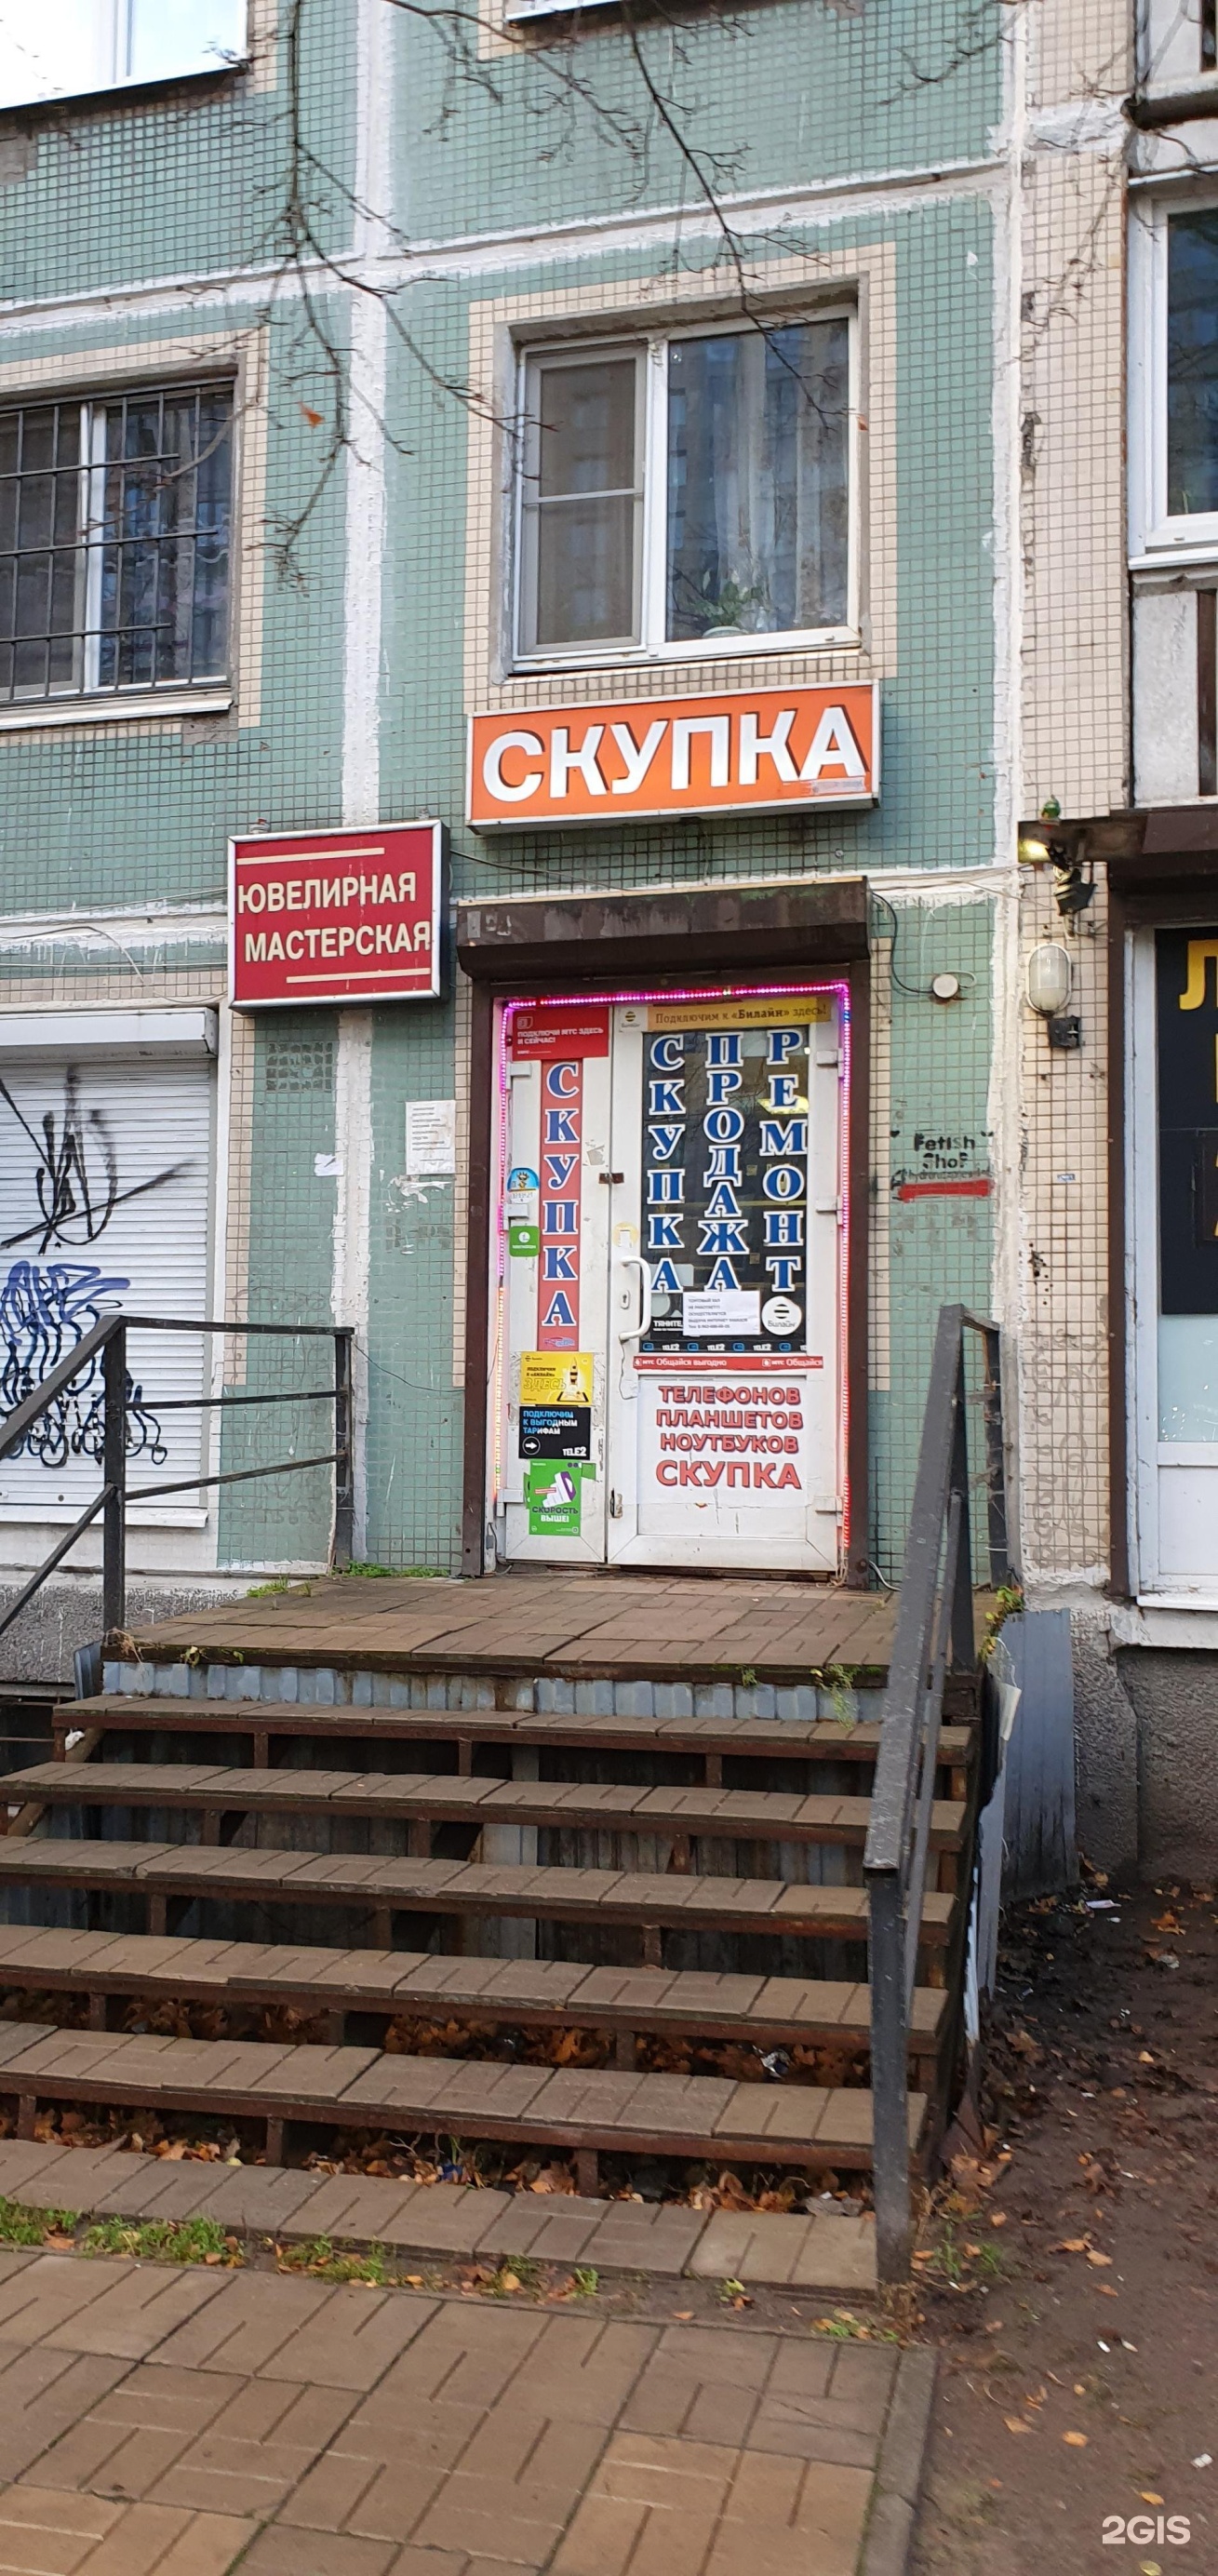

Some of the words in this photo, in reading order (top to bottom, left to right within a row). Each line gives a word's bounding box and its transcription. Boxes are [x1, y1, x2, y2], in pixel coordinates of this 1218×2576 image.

[482, 706, 870, 802] СКУПКА
[237, 872, 416, 914] ЮВЕЛИРНАЯ
[245, 921, 431, 962] МАСТЕРСКАЯ
[655, 1012, 719, 1024] Подключим
[731, 1008, 789, 1020] «Билайн»
[793, 1004, 827, 1016] здесь!
[579, 1026, 604, 1035] ЗДЕСЬ
[647, 1034, 687, 1294] СКУПКА
[696, 1031, 750, 1292] ПРОДАЖА
[758, 1028, 809, 1293] РЕМОНТ
[542, 1061, 581, 1327] СКУПКА
[524, 1377, 567, 1392] ЗДЕСЬ
[658, 1386, 801, 1406] ТЕЛЕФОНОВ
[656, 1409, 804, 1429] ПЛАНШЕТОВ
[523, 1427, 561, 1435] ТАРИФАМ
[562, 1446, 587, 1456] TELE2
[660, 1432, 799, 1454] НОУТБУКОВ
[655, 1459, 802, 1490] СКУПКА
[531, 1506, 579, 1515] СКОРОСТЬ
